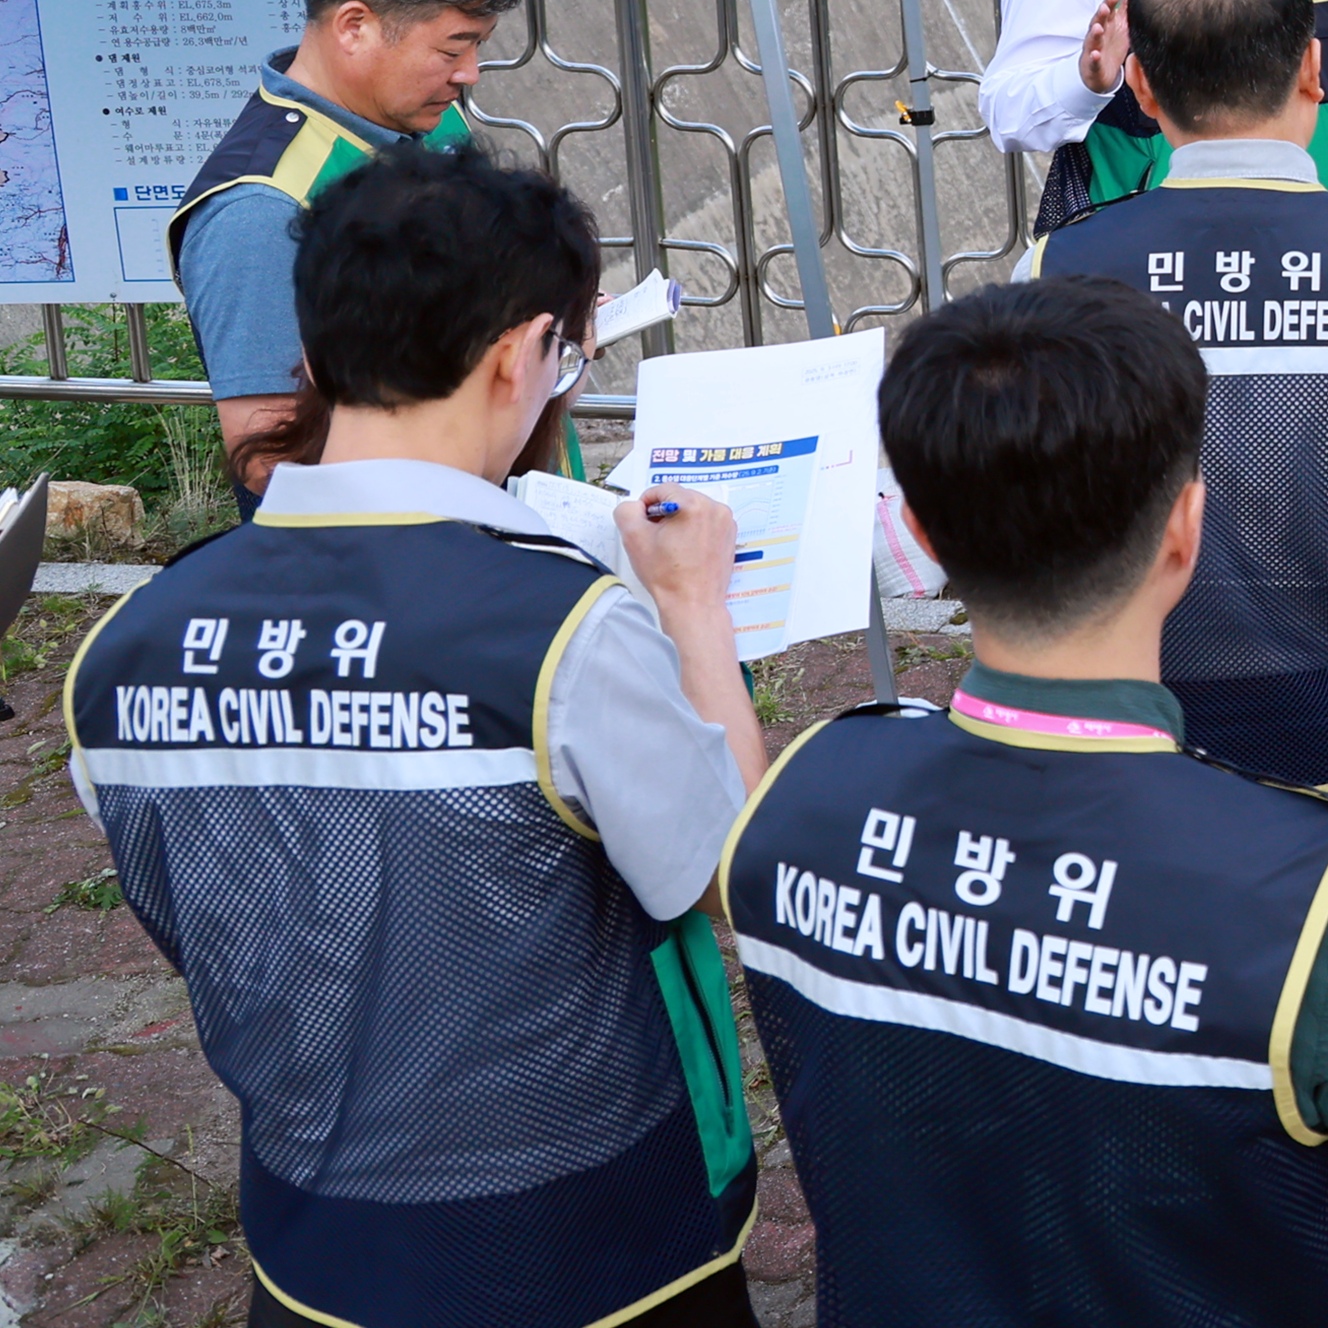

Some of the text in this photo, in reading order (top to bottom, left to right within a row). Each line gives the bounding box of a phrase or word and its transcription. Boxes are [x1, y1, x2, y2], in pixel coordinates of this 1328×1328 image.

[178, 0, 232, 10] EL.675.3m
[179, 13, 233, 22] EL.662.0m
[109, 25, 168, 35] 유효저수용량
[124, 37, 171, 48] 용수공급량
[108, 53, 141, 63] 댐 제원
[186, 78, 240, 88] EL.678.5m
[115, 106, 168, 116] 여수로 제원
[134, 184, 186, 202] 단면도
[1147, 250, 1322, 293] 민 방 위
[1183, 299, 1255, 342] CIVIL
[652, 443, 783, 463] 전망 및 가뭄 대응 계획
[182, 618, 387, 678] 민 방 위
[116, 685, 473, 748] KOREA CIVIL DEFENSE
[856, 807, 1118, 930] 민 방 위
[775, 862, 1208, 1032] KOREA CIVIL DEFENSE
